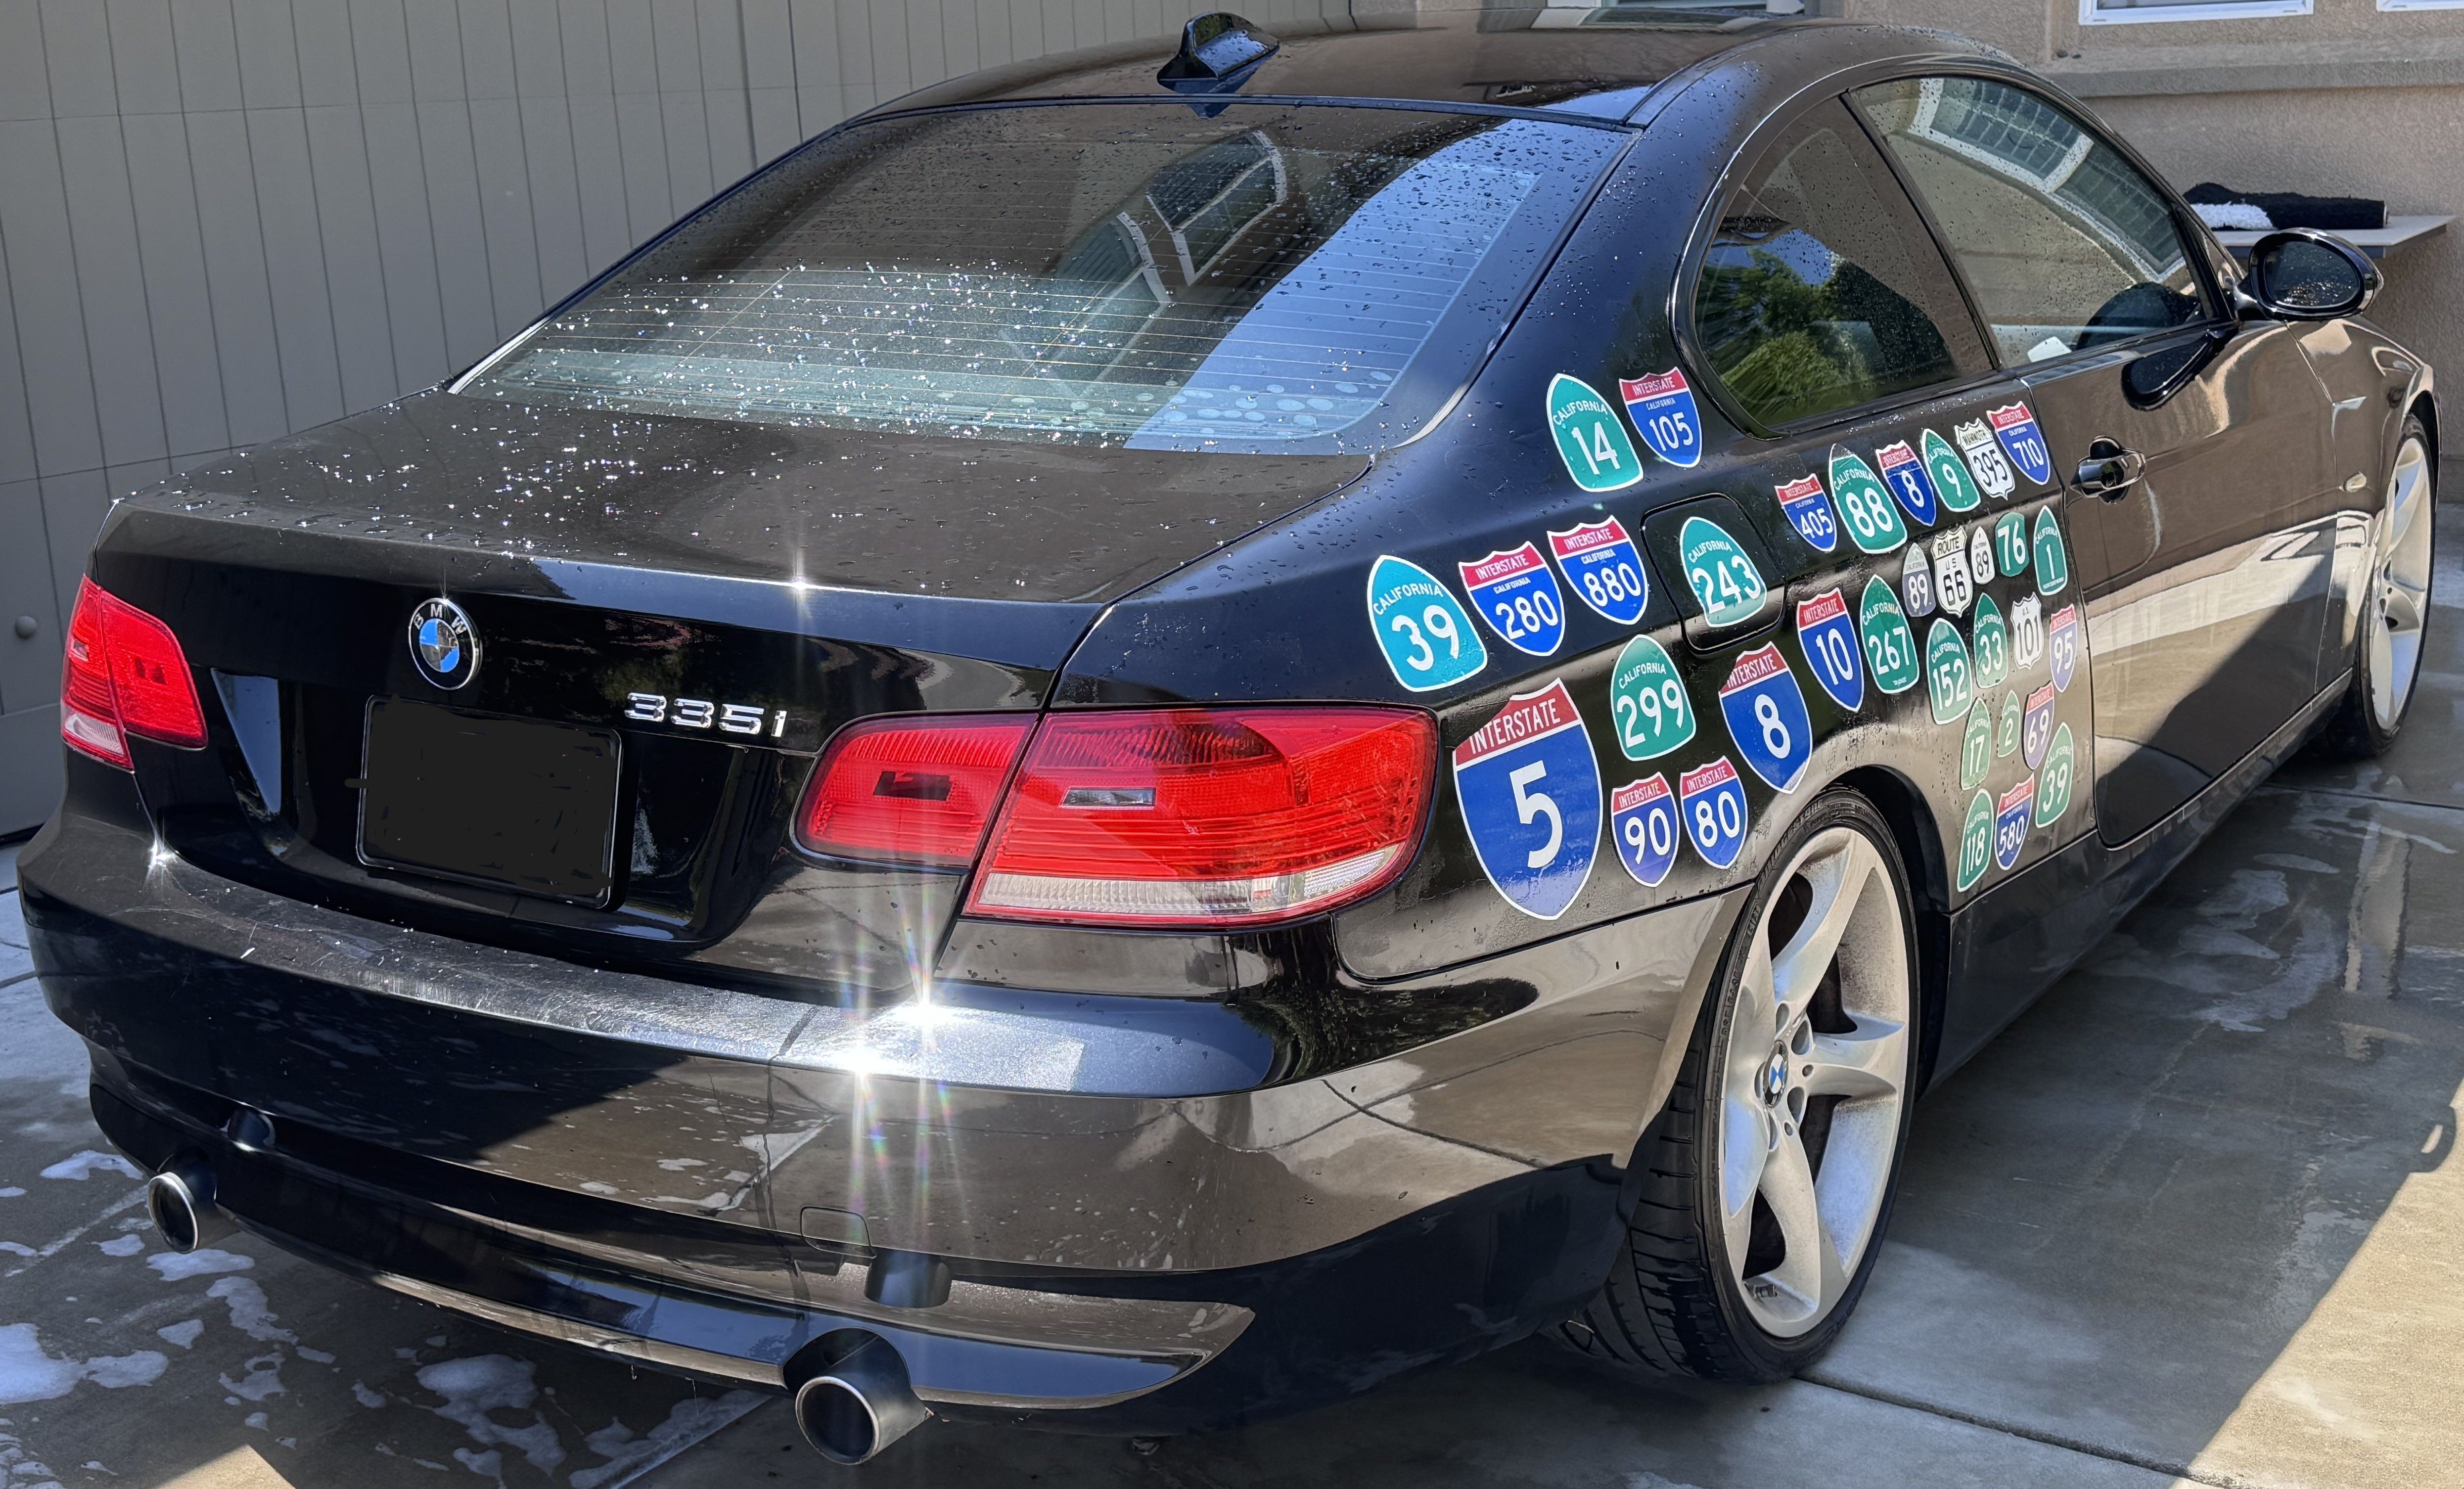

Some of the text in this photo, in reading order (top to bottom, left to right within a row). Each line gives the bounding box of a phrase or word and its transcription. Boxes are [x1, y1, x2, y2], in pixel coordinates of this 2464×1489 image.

[1632, 376, 1676, 396] INTERSTATE
[1646, 398, 1676, 410] CALIFORNIA
[1553, 400, 1607, 425] CALIFORNIA
[1571, 421, 1620, 475] 14
[1648, 412, 1693, 452] 105
[1973, 449, 2008, 487] 395
[2012, 438, 2044, 470] 710
[1784, 483, 1814, 497] INTERSTATE
[1833, 469, 1875, 491] CALIFORNIA
[1901, 470, 1924, 507] 8
[1942, 463, 1962, 497] 9
[1800, 508, 1833, 539] 405
[1846, 487, 1893, 538] 88
[1563, 528, 1614, 550] INTERSTATE
[1581, 548, 1615, 565] CALIFORNIA
[1688, 541, 1732, 563] CALIFORNIA
[1937, 538, 1960, 555] ROUTE
[1998, 521, 2026, 571] 76
[1474, 555, 1530, 580] INTERSTATE
[1976, 550, 1989, 578] 89
[2046, 544, 2055, 579] 1
[1372, 584, 1443, 615] CALIFORNIA
[1493, 577, 1531, 594] CALIFORNIA
[1584, 562, 1641, 607] 880
[1692, 555, 1761, 614] 243
[1908, 574, 1928, 609] 89
[1943, 570, 1966, 606] 66
[413, 604, 467, 634] BMW
[1496, 590, 1558, 640] 280
[1803, 599, 1839, 624] INTERSTATE
[1862, 604, 1900, 626] CALIFORNIA
[1975, 614, 2002, 633] CALIFORNIA
[1392, 605, 1460, 671] 39
[1869, 626, 1910, 676] 267
[1931, 642, 1960, 663] CALIFORNIA
[1980, 631, 2003, 675] 33
[2017, 615, 2040, 660] 101
[2054, 631, 2073, 675] 95
[1815, 628, 1853, 685] 10
[1618, 663, 1667, 689] CALIFORNIA
[1933, 658, 1966, 711] 152
[624, 692, 787, 737] 335i
[1469, 698, 1560, 754] INTERSTATE
[1616, 679, 1684, 747] 299
[1755, 694, 1791, 759] 8
[2005, 718, 2013, 747] 2
[2028, 709, 2049, 754] 69
[1969, 734, 1985, 776] 17
[1618, 782, 1661, 809] INTERSTATE
[1687, 766, 1728, 792] INTERSTATE
[2043, 763, 2067, 812] 39
[1509, 760, 1563, 868] 5
[1695, 791, 1740, 848] 80
[1967, 812, 1989, 834] CALIFORNIA
[1625, 808, 1670, 864] 90
[1966, 827, 1985, 876] 118
[1999, 815, 2024, 857] 580
